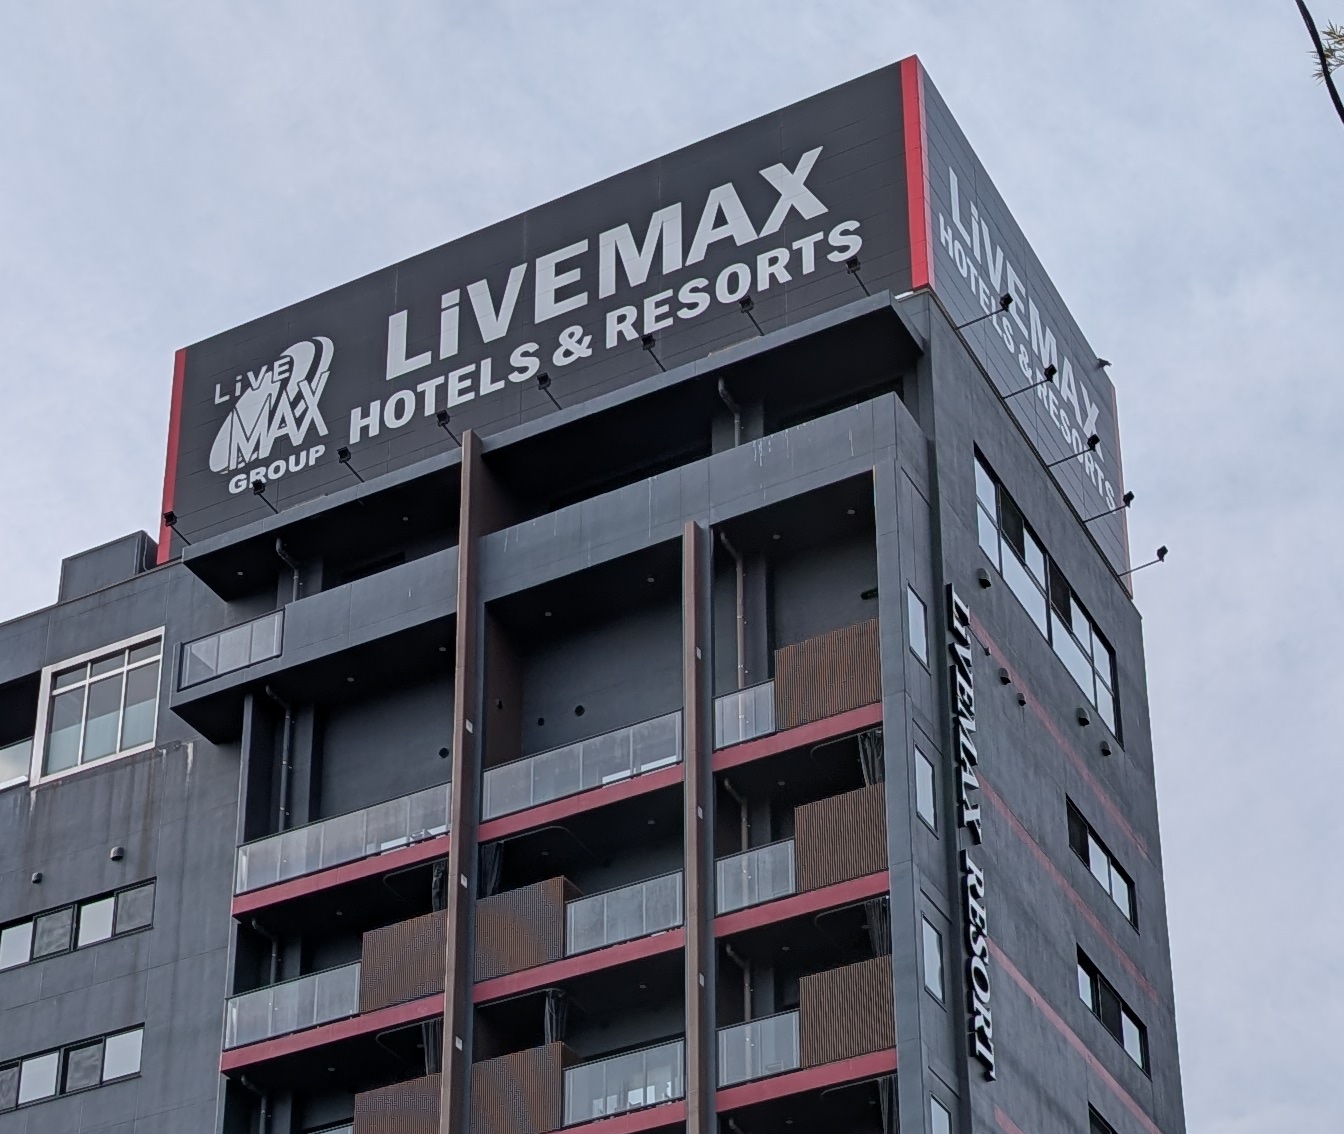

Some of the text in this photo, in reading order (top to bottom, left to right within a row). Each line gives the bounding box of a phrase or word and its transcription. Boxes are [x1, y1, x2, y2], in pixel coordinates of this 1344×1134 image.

[348, 220, 863, 446] HOTELS & RESORTS
[385, 145, 829, 381] LiVEMAX
[938, 212, 1117, 515] HOTELS & RESORTS
[948, 166, 1105, 463] LiVEMAX
[214, 356, 291, 405] LiVE
[228, 444, 326, 494] GROUP
[229, 370, 331, 471] MAX
[962, 849, 996, 1081] RESORT
